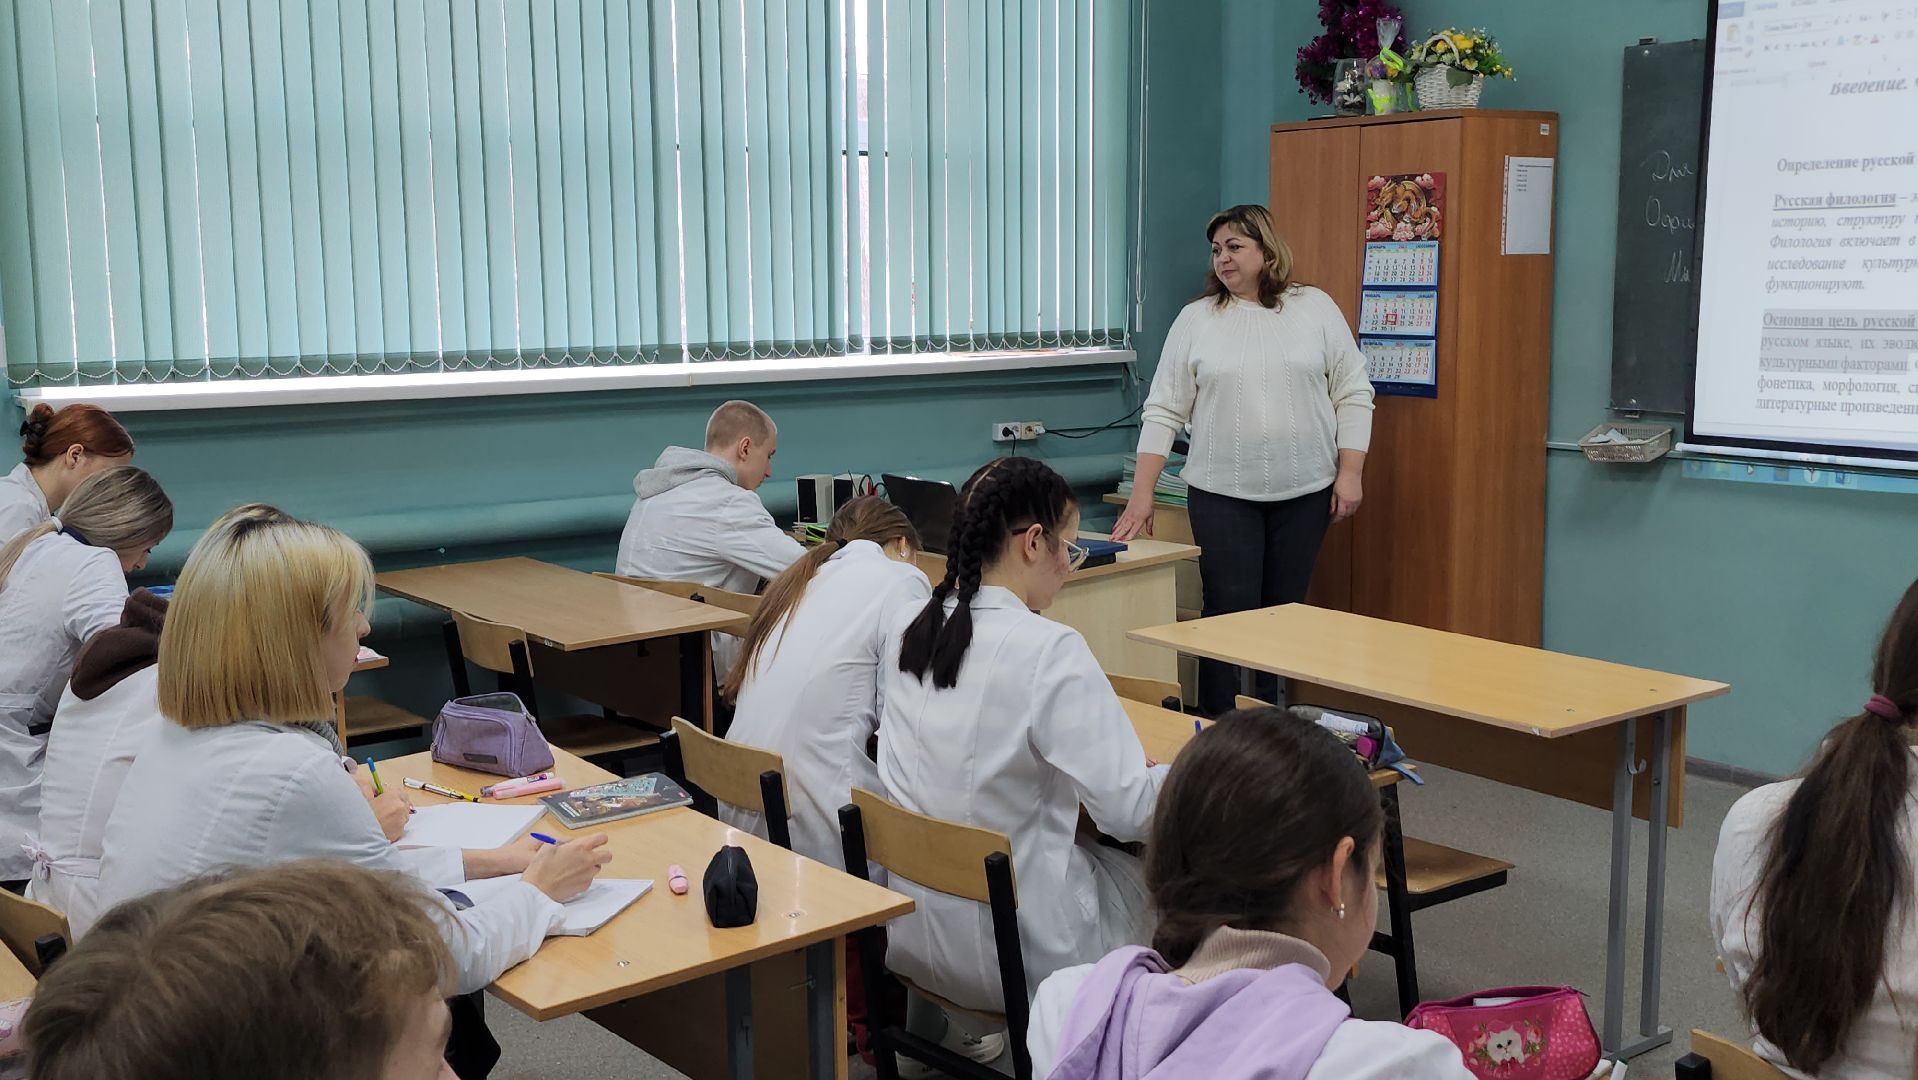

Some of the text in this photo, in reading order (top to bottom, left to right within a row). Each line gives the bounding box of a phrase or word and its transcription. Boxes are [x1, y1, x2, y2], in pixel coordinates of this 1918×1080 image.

[1777, 152, 1914, 175] Определение русской
[1774, 194, 1823, 209] Русская
[1825, 193, 1896, 207] филология
[1771, 215, 1906, 231] историю, структуру
[1770, 235, 1832, 248] Филология
[1840, 236, 1900, 247] включает
[1767, 257, 1847, 271] исследование
[1765, 276, 1865, 293] функционируют.
[1763, 312, 1915, 329] Основная цель русской
[1761, 337, 1809, 350] русском
[1759, 357, 1840, 372] культурными
[1822, 378, 1900, 395] морфология,
